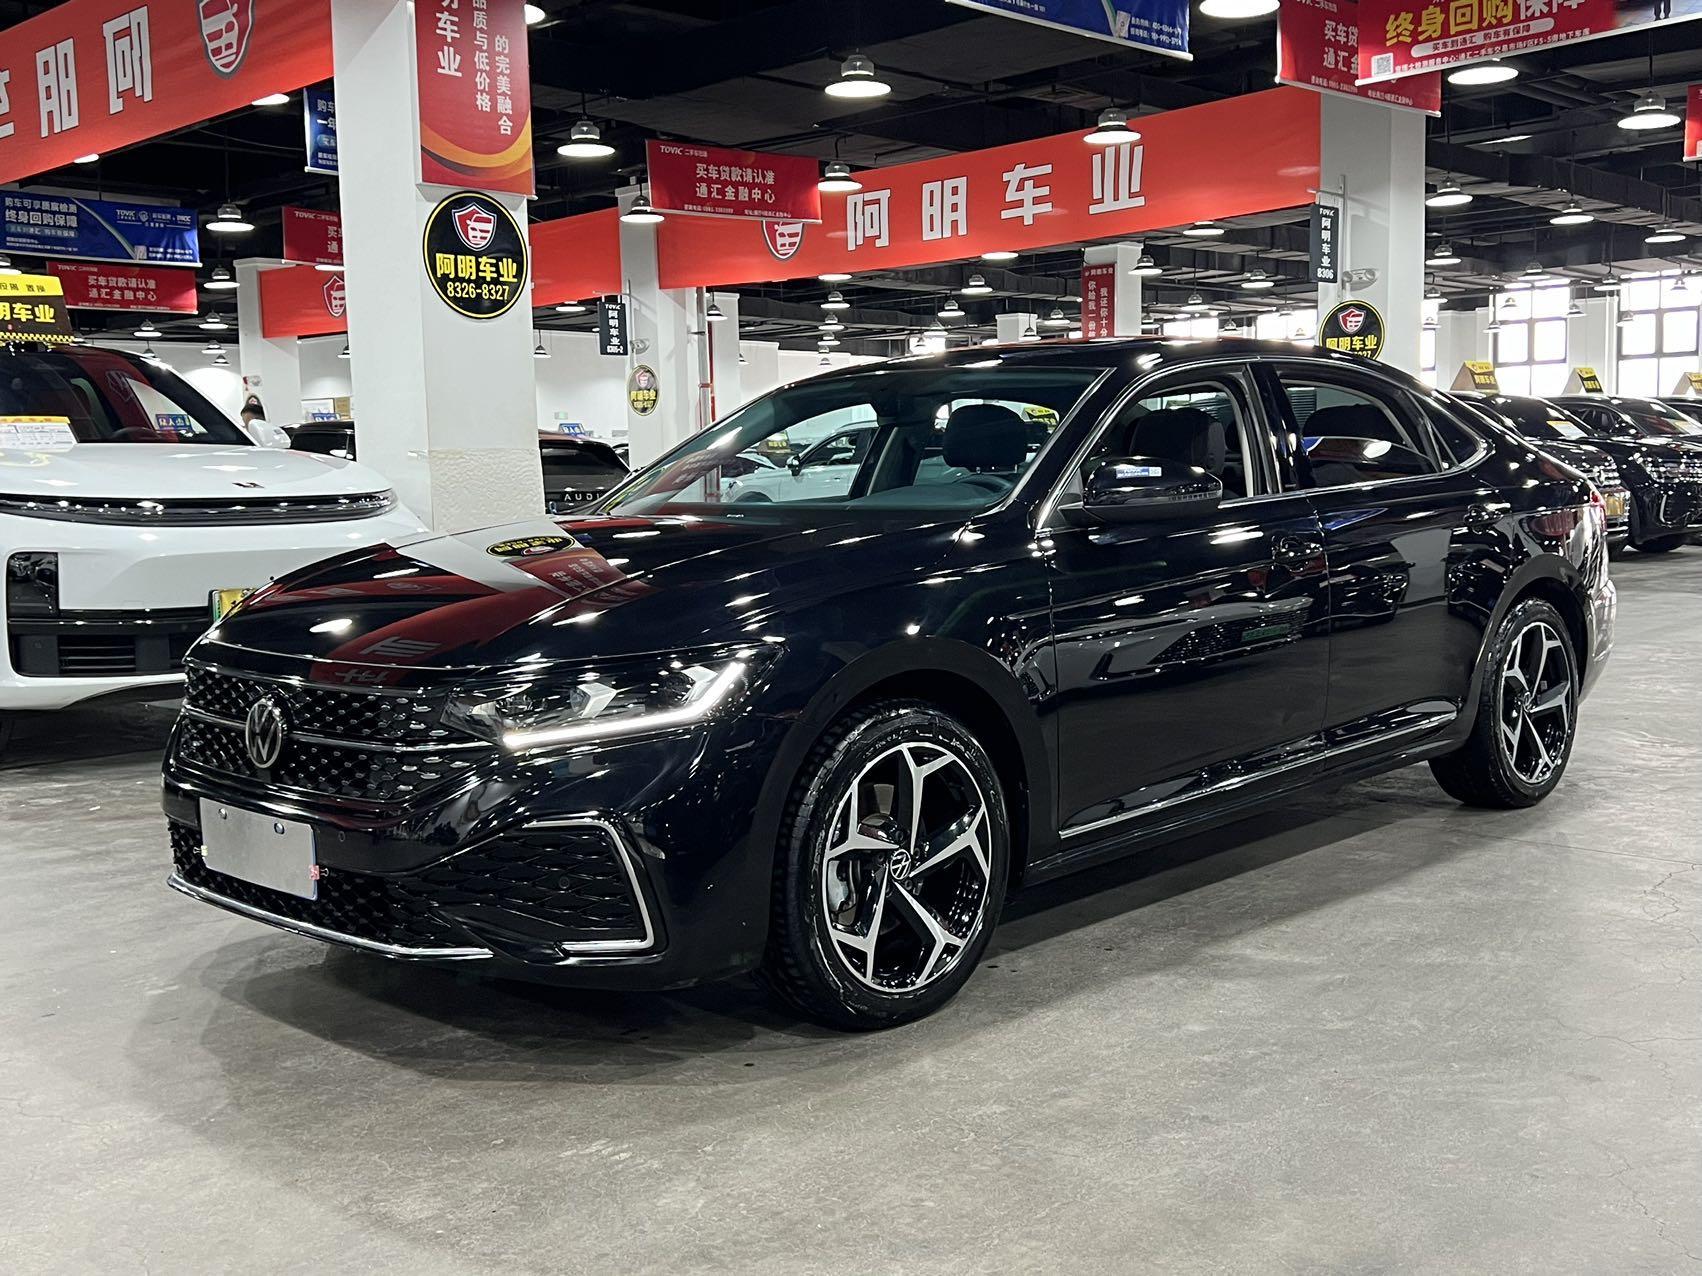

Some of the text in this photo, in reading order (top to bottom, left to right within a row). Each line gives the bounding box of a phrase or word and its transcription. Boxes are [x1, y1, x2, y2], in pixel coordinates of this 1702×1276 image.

[435, 0, 462, 78] 车业
[495, 35, 513, 136] 的完美融合
[696, 163, 775, 185] 买车贷款请认准
[696, 182, 775, 203] 通汇金融中心
[847, 142, 1146, 251] 阿明车业
[5, 208, 78, 228] 终身回购保障
[1321, 217, 1332, 268] 阿明车业
[435, 253, 518, 283] 阿明车业
[88, 275, 157, 290] 买车贷款请认准
[446, 282, 510, 301] 8326-8327
[89, 287, 157, 302] 通汇金融中心
[608, 310, 621, 346] 阿明车业
[1326, 334, 1377, 351] 阿明车业
